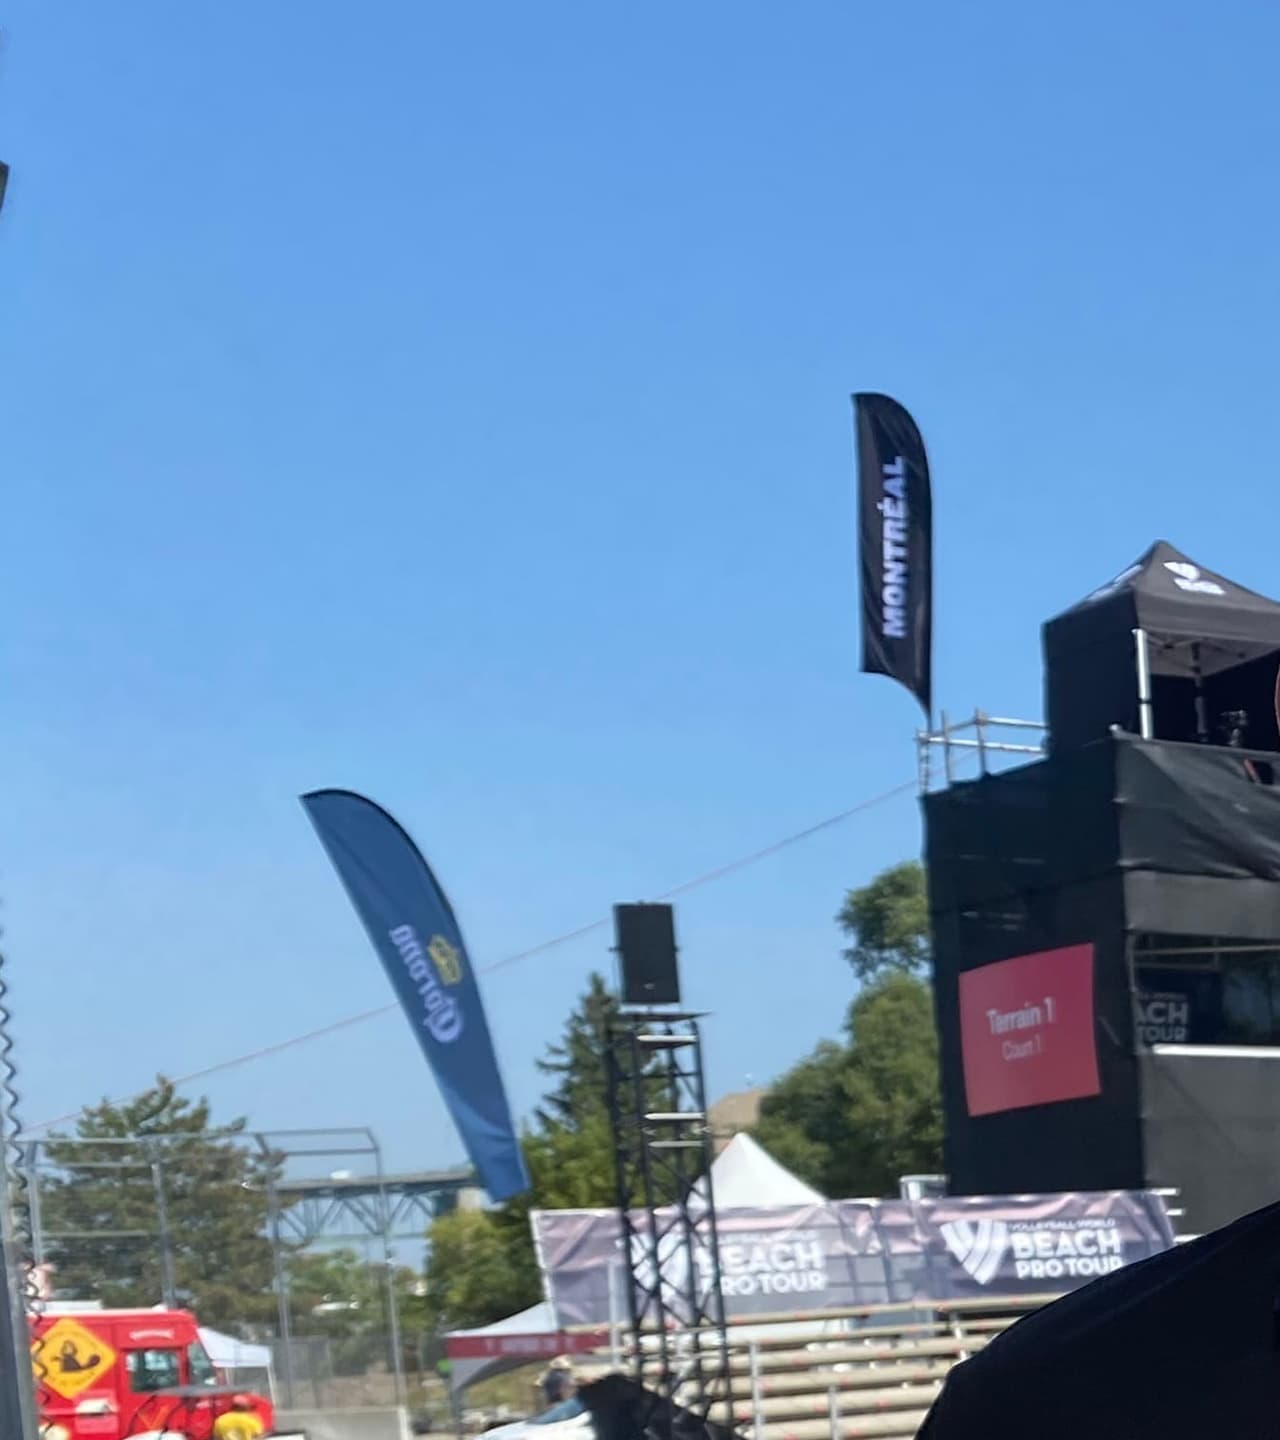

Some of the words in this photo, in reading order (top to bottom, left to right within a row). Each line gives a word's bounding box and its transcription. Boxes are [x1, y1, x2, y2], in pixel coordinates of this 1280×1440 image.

[876, 456, 908, 638] MONTRÉAL
[986, 1000, 1042, 1035] Terrain
[1043, 997, 1054, 1023] 1
[1010, 1228, 1121, 1259] BEACH
[757, 1271, 828, 1294] TOUR
[1015, 1259, 1062, 1280] PRO
